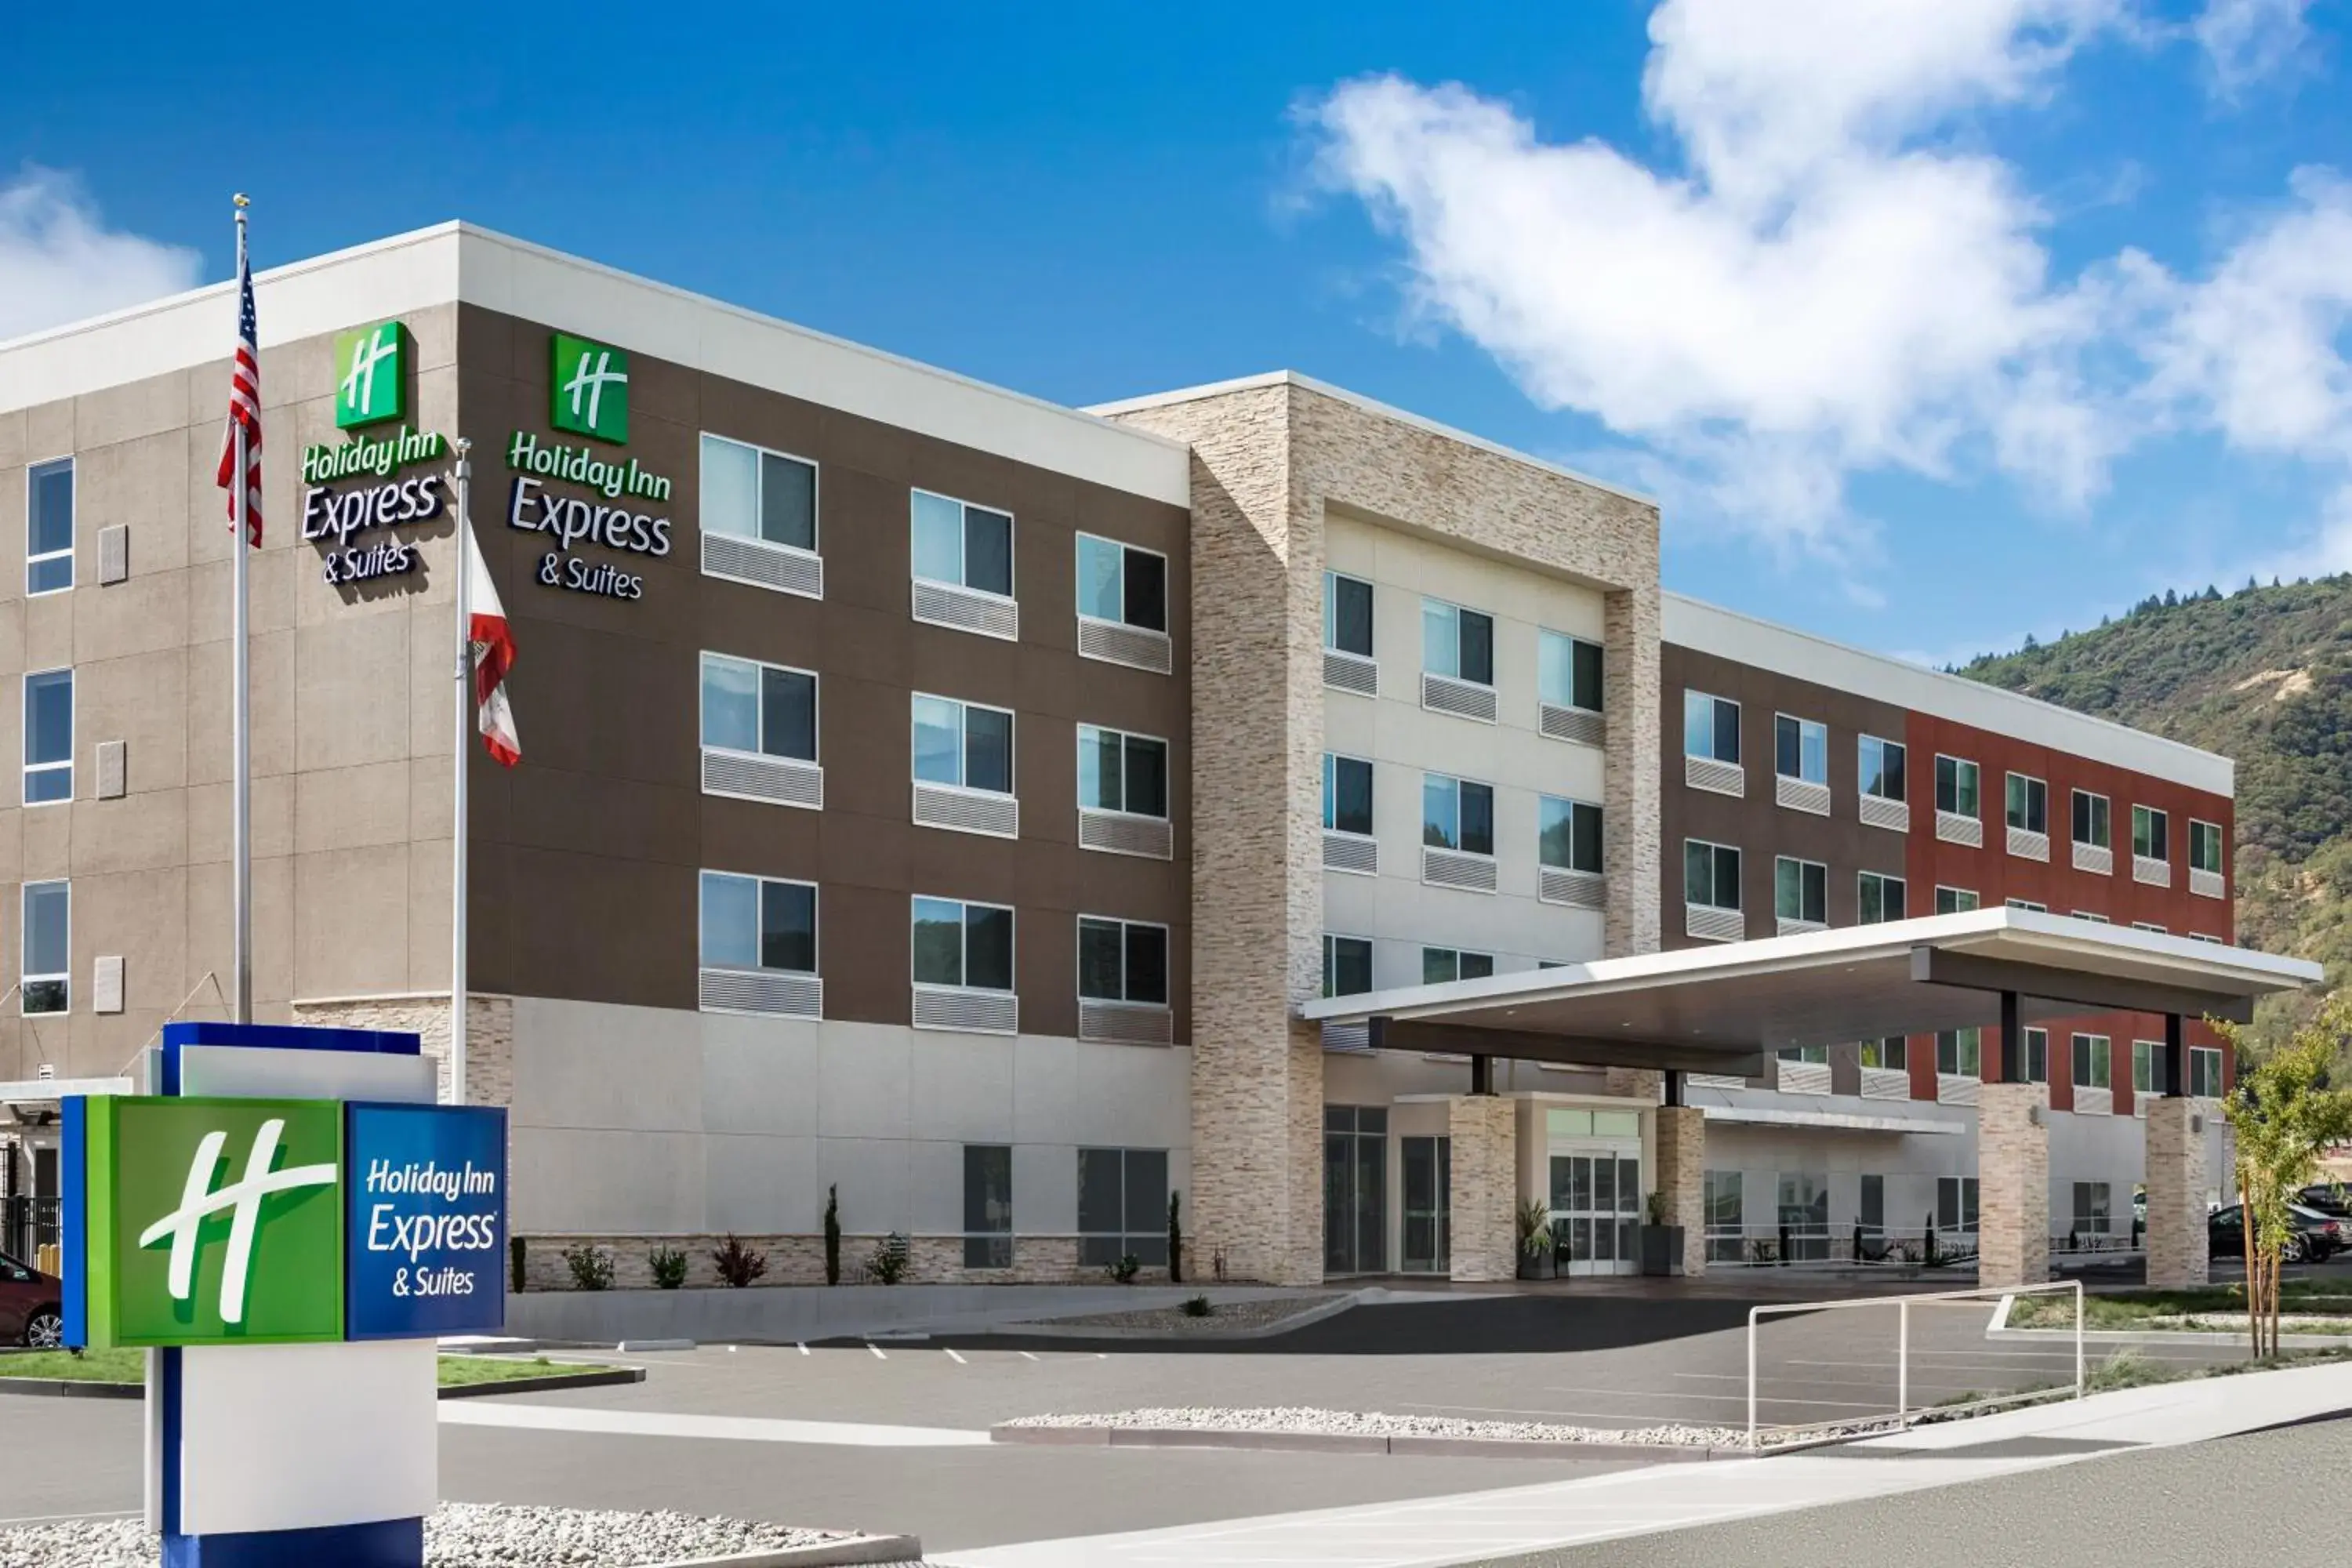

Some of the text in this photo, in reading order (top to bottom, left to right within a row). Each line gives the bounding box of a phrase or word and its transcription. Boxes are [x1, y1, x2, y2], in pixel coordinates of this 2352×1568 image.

[302, 424, 437, 484] Holiday Inn
[511, 431, 670, 500] Holiday Inn
[301, 476, 438, 545] Express
[511, 476, 670, 555] Express
[322, 543, 410, 584] & Suites
[541, 553, 643, 599] & Suites
[366, 1159, 495, 1202] Holiday Inn
[368, 1203, 495, 1264] Express
[393, 1266, 474, 1296] & Suites
